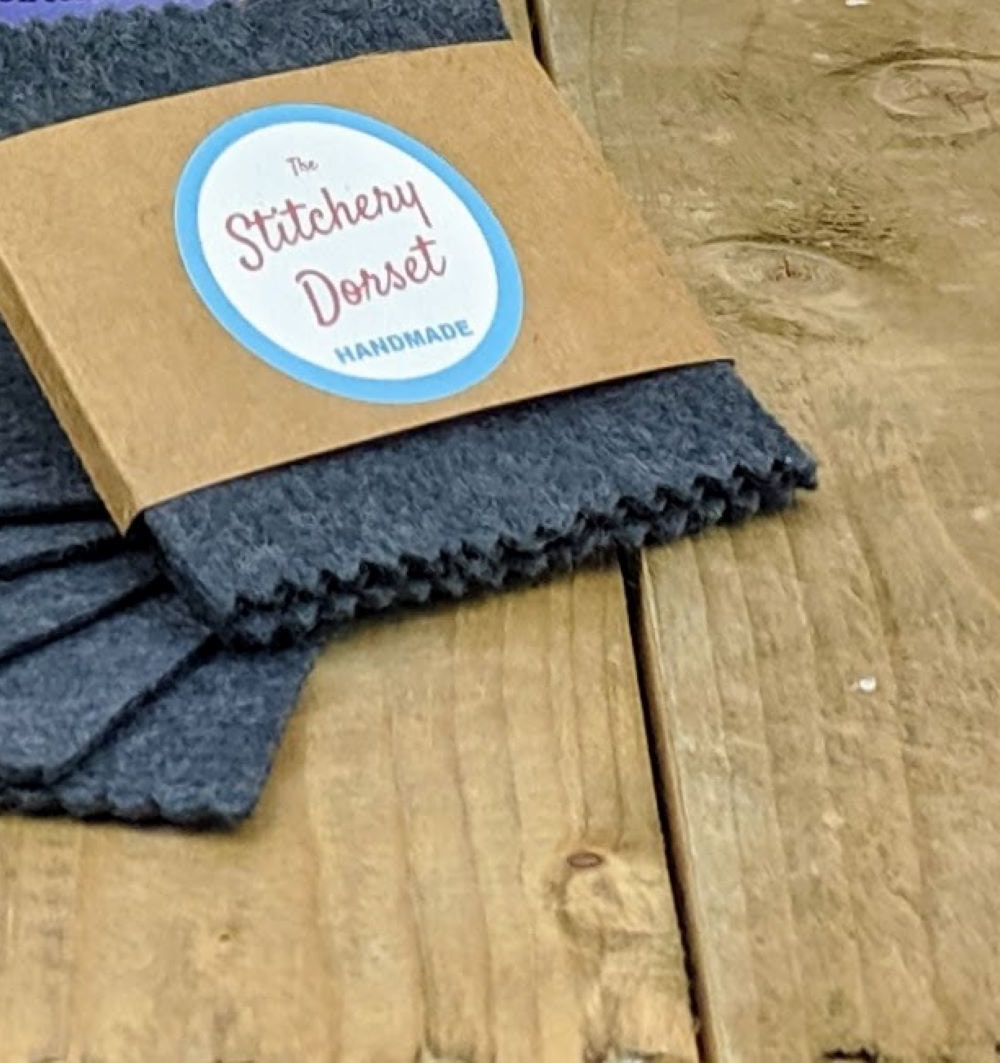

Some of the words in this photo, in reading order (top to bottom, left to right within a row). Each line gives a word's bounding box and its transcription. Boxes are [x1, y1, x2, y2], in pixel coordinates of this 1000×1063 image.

[286, 155, 320, 177] The
[224, 180, 434, 272] Stitchery
[295, 234, 447, 328] Dorset
[333, 319, 475, 366] HANDMADE
